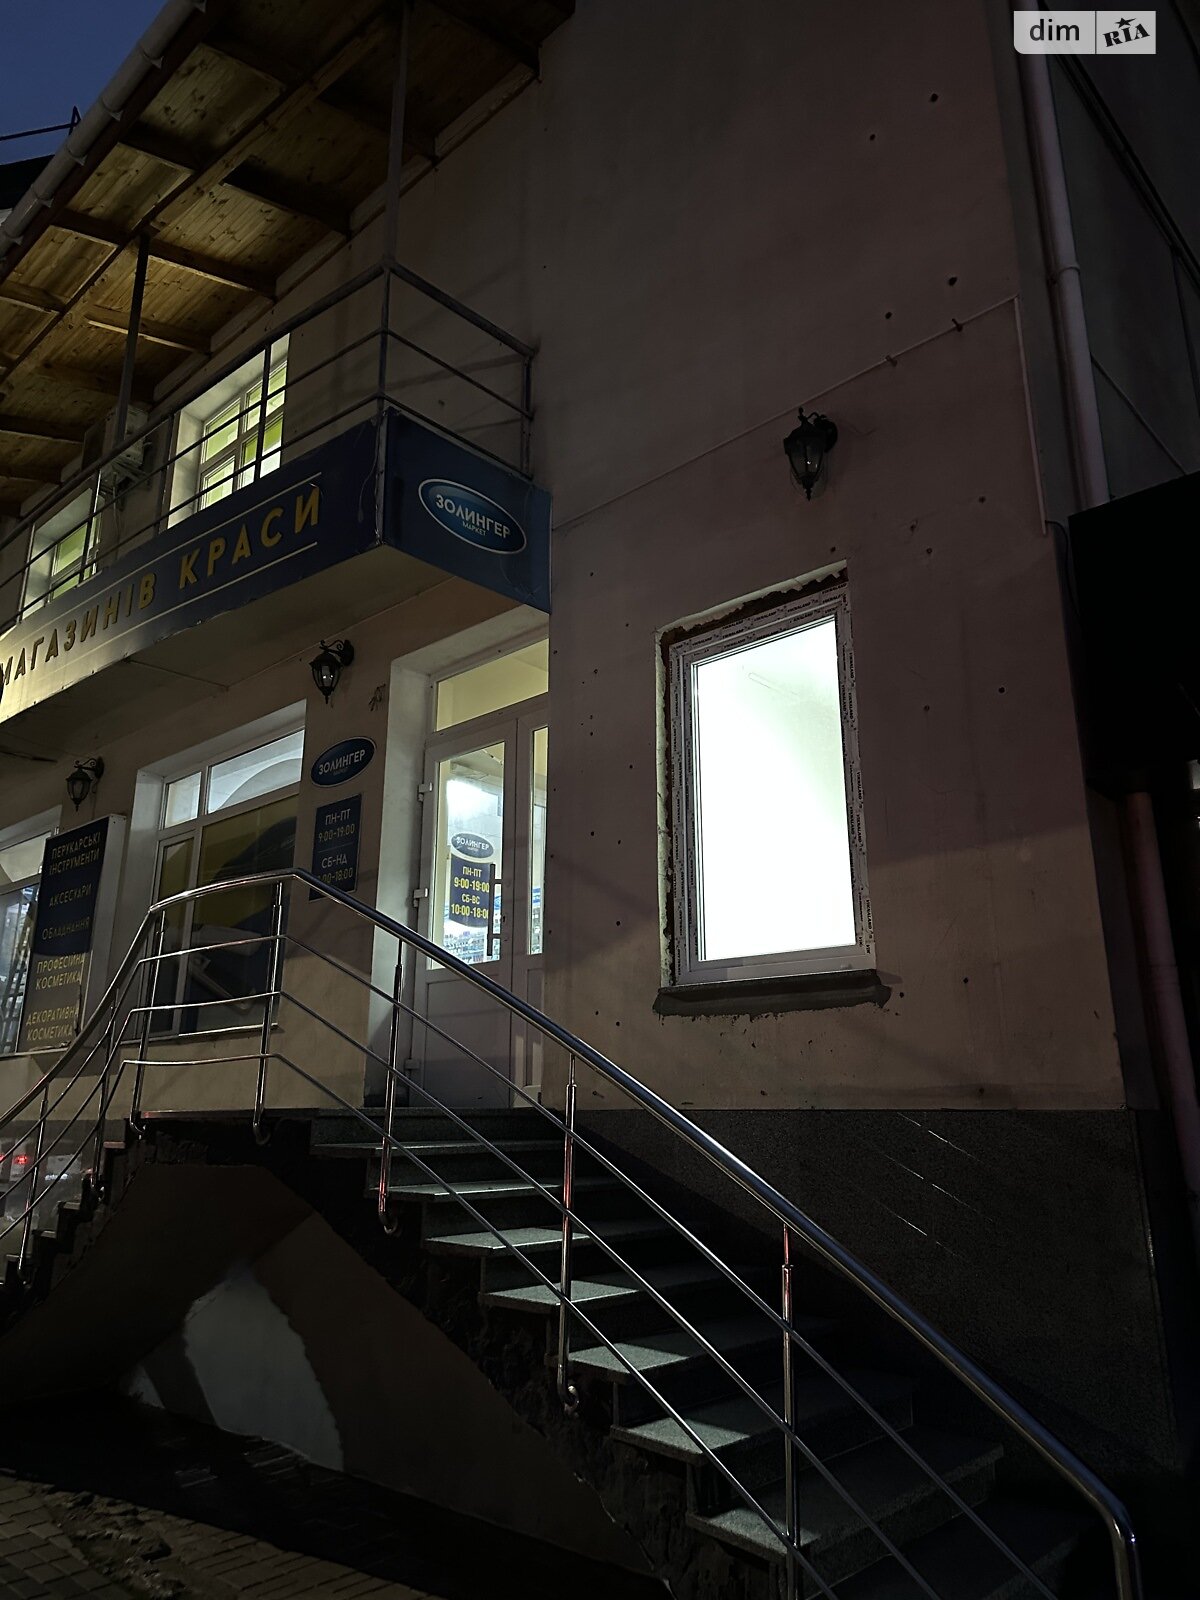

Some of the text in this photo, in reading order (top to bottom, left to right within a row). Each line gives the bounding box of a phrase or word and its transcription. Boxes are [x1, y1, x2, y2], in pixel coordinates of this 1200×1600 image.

[435, 493, 512, 539] ЗОЛИНГЕР
[179, 484, 320, 590] КРАСИ
[318, 748, 366, 776] ЗОЛИНГЕР
[325, 807, 352, 826] ПН-ПТ
[51, 831, 101, 860] ПЕРУКАРСЬКІ
[456, 836, 490, 851] ЗОЛИНГЕР
[49, 847, 100, 876] ІНСТРУМЕНТИ
[321, 852, 348, 869] СБ-НД
[462, 865, 483, 878] ПН-ПТ
[453, 876, 490, 893] 9:00-19:00
[49, 883, 92, 909] АКСЕСУАРИ
[42, 915, 90, 941] ОБЛАДНАННЯ
[36, 970, 82, 990] КОСМЕТИКА
[25, 1005, 79, 1026] ДЕКОРАТИВНА
[27, 1024, 73, 1041] КОСМЕТИКА
